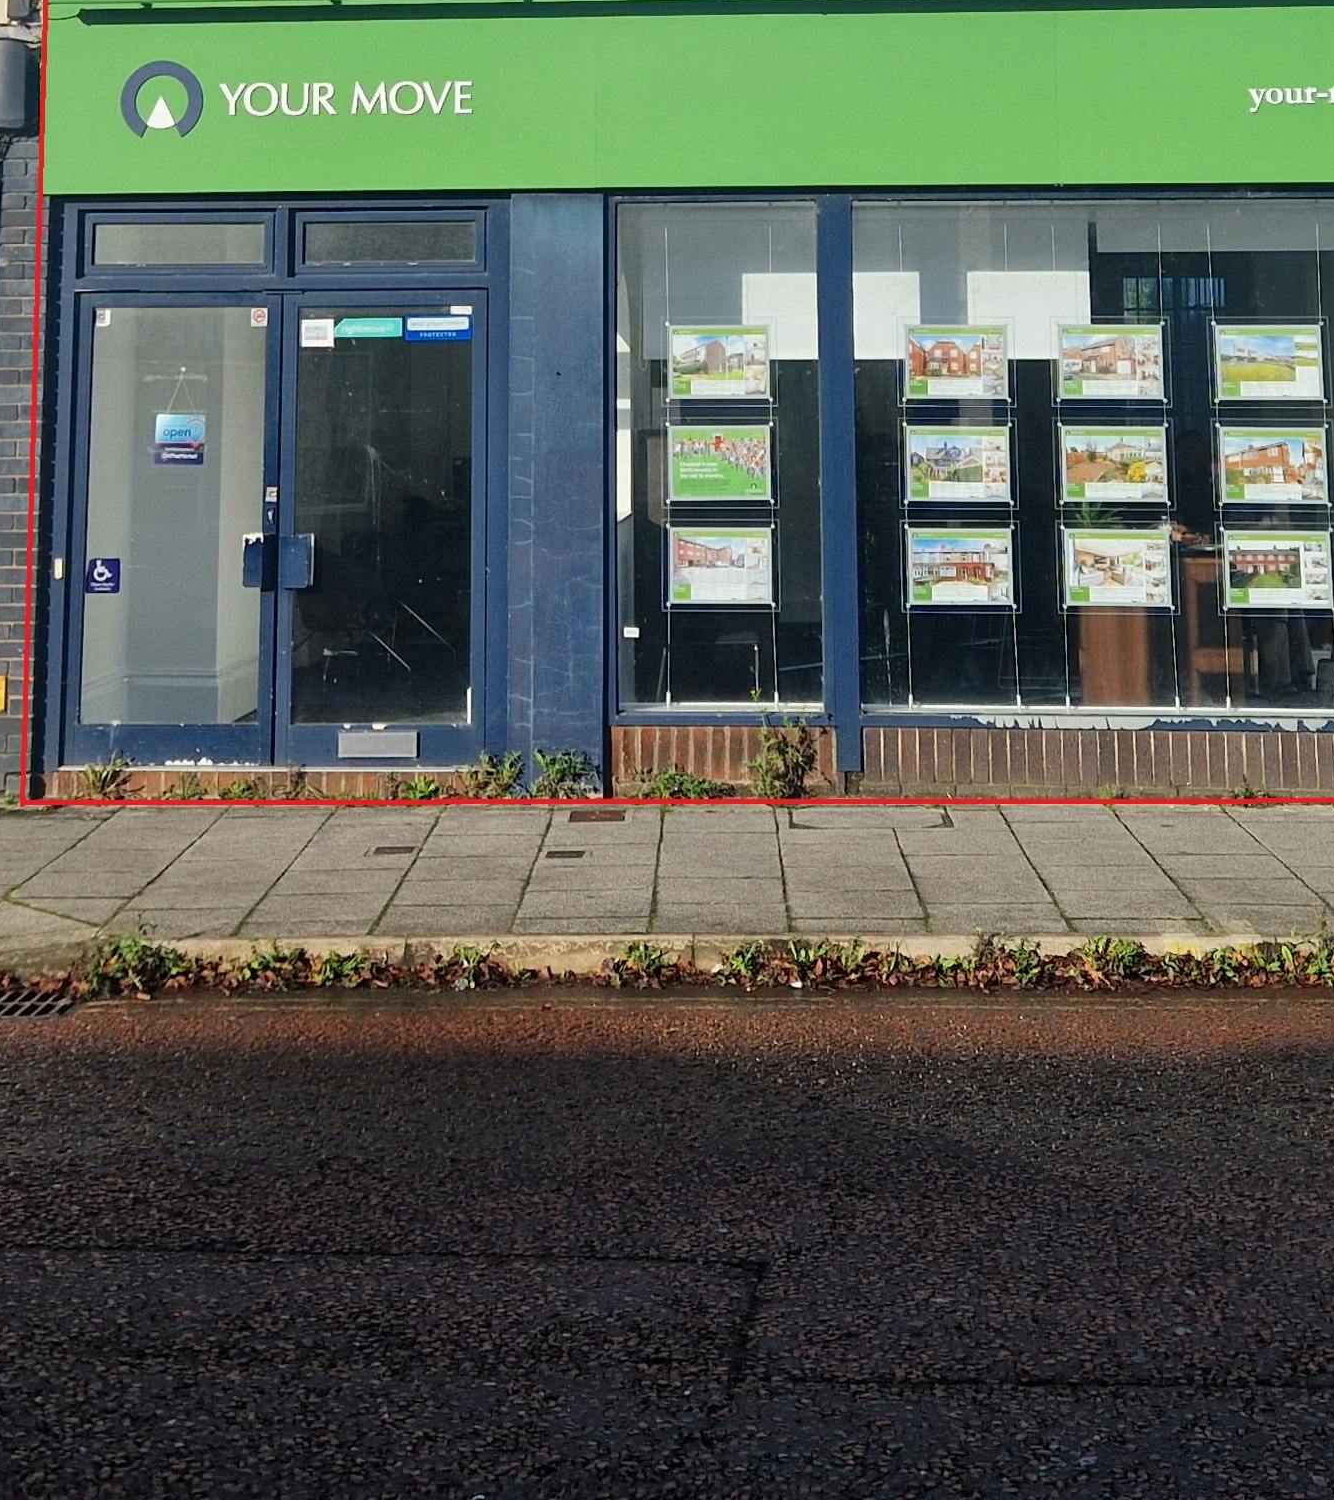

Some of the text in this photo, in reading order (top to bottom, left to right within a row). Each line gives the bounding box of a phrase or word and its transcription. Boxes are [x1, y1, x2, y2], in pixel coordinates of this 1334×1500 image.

[219, 80, 474, 117] YOUR MOVE
[162, 428, 192, 439] open
